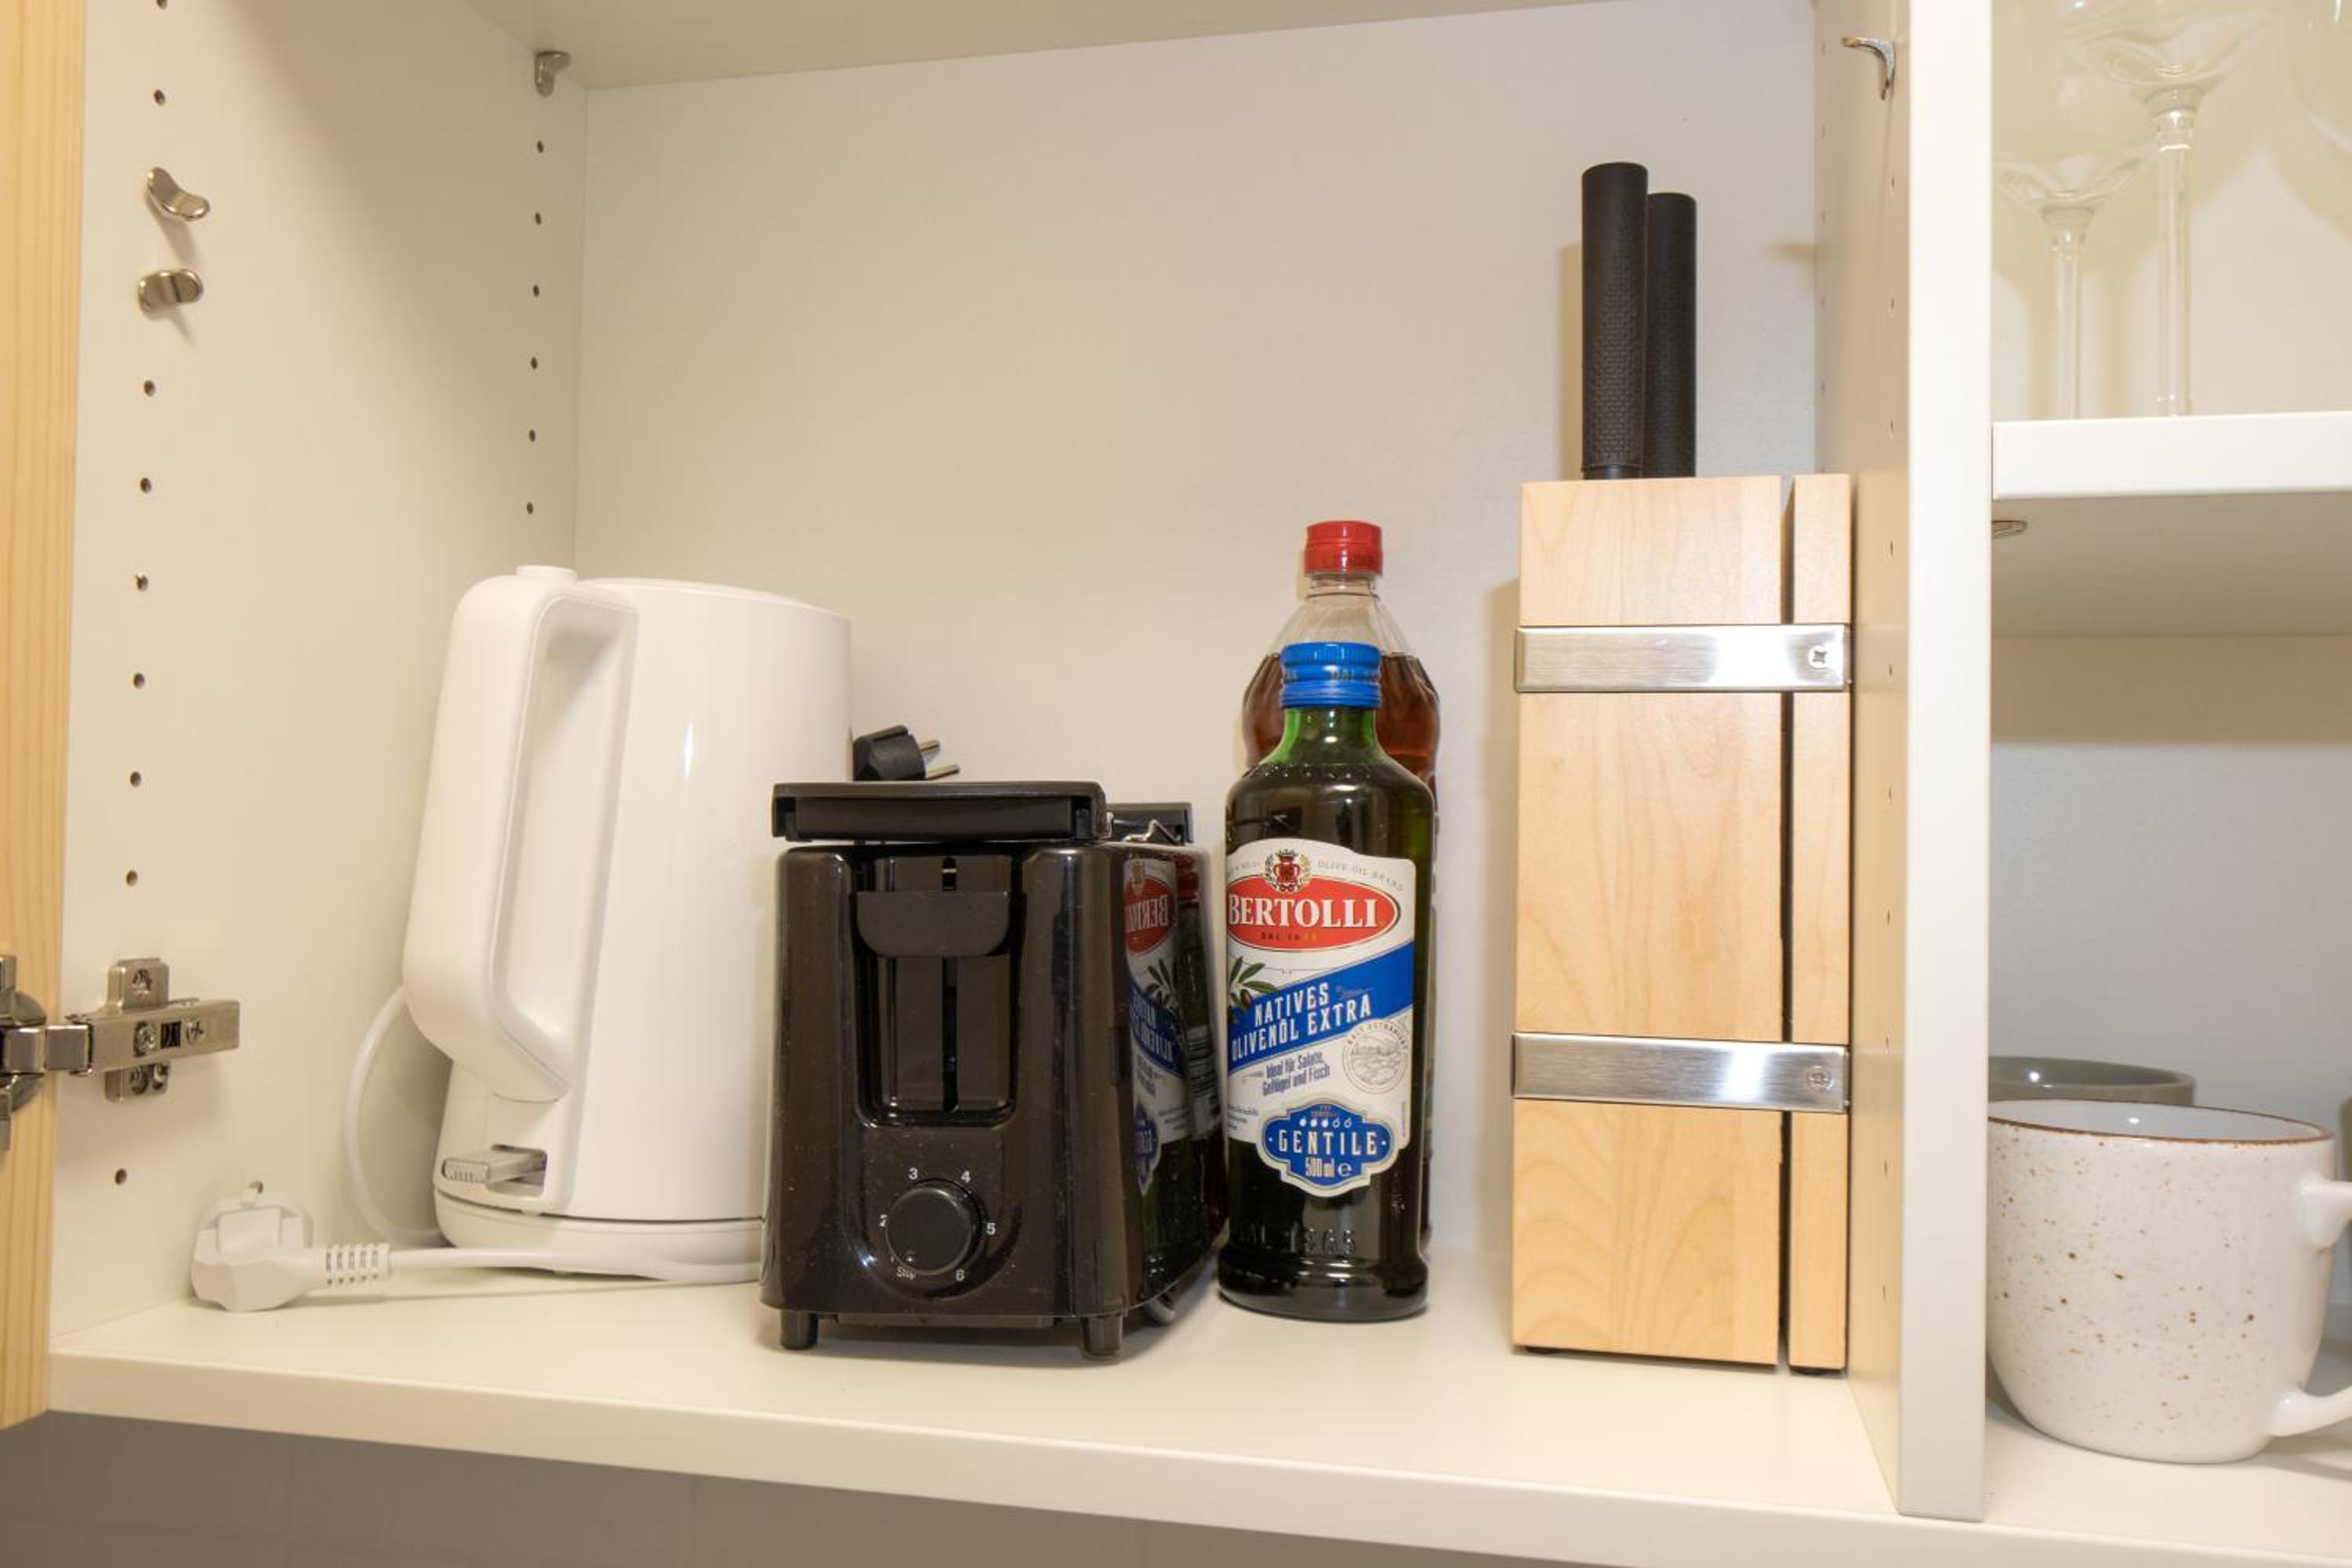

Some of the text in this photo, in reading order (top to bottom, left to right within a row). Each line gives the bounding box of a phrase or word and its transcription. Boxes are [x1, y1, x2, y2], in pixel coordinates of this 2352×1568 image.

[1229, 894, 1377, 928] BERTOLLI
[1254, 982, 1330, 1027] NATIVES
[1307, 993, 1371, 1036] EXTRA
[1278, 1130, 1377, 1156] GENTILE
[909, 1167, 919, 1180] 3
[960, 1171, 971, 1182] 4
[986, 1222, 996, 1236] 5
[956, 1269, 965, 1281] 6
